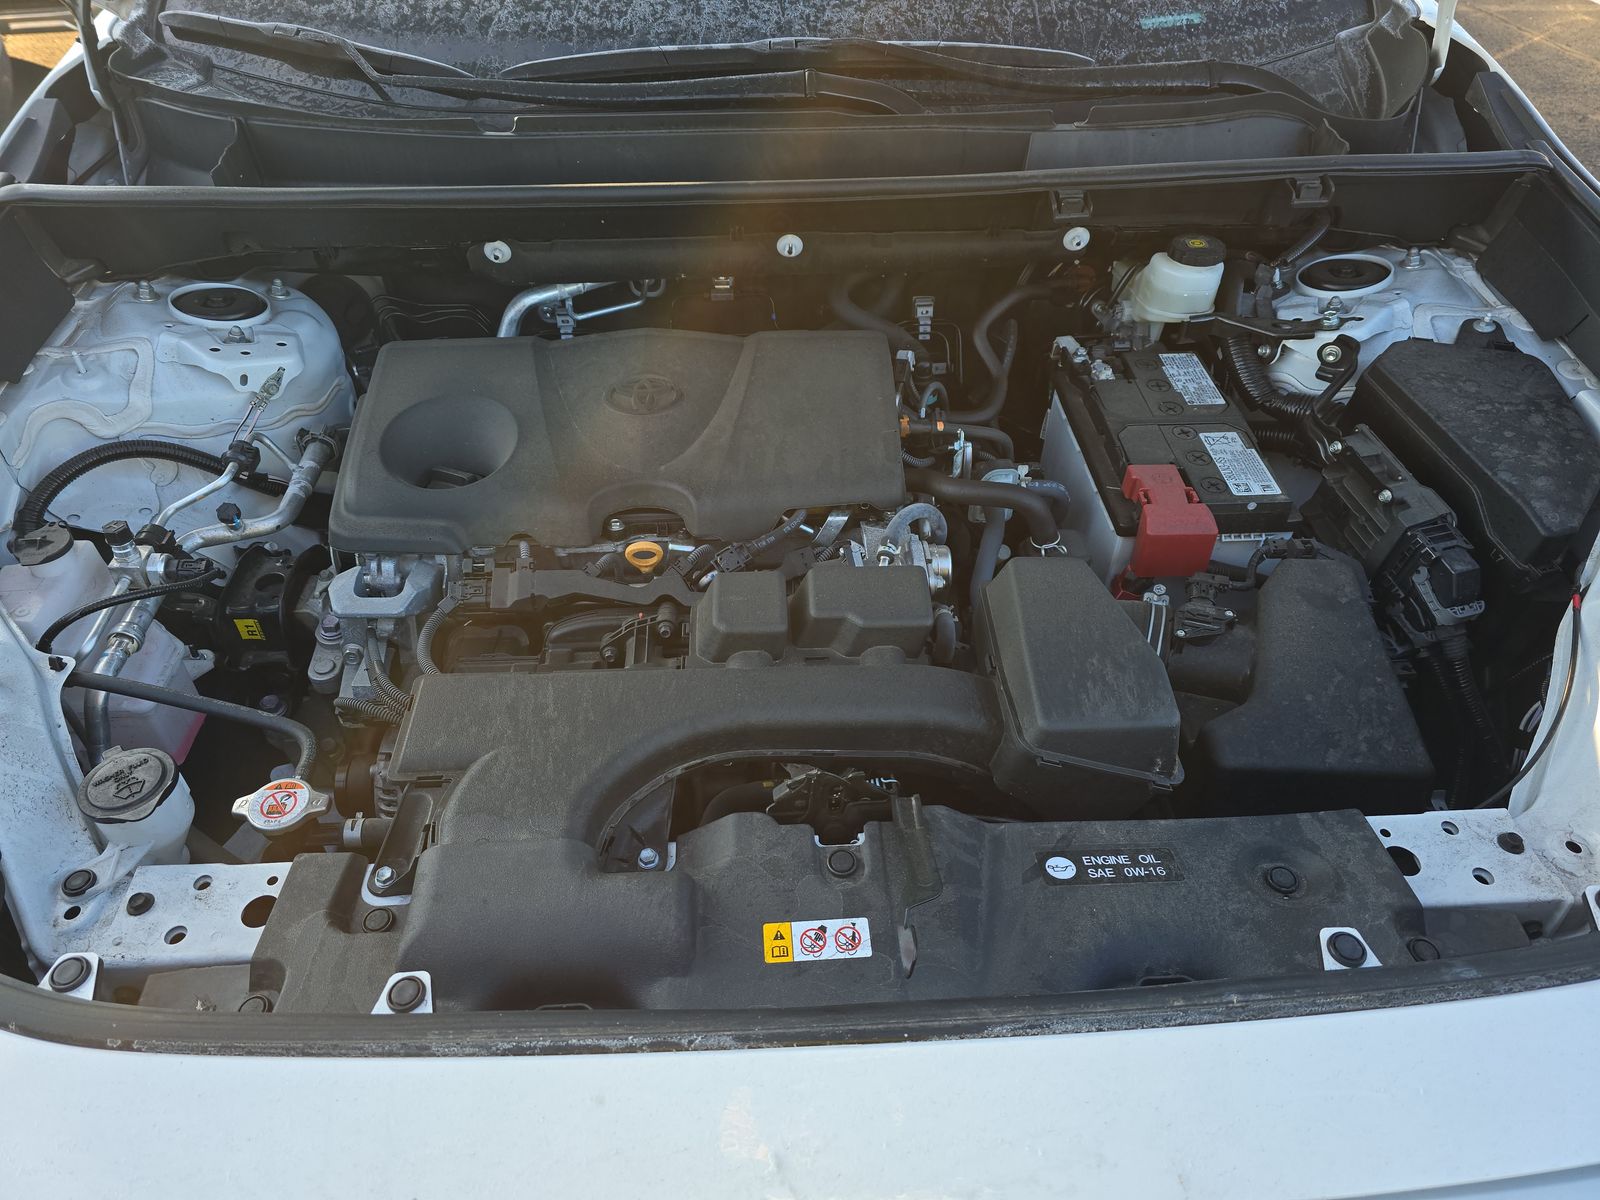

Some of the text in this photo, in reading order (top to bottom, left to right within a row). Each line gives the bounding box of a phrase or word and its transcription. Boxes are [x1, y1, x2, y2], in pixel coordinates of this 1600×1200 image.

[244, 624, 258, 636] R1
[1082, 854, 1161, 866] ENGINE OIL
[1088, 866, 1166, 878] SAE 0W-16
